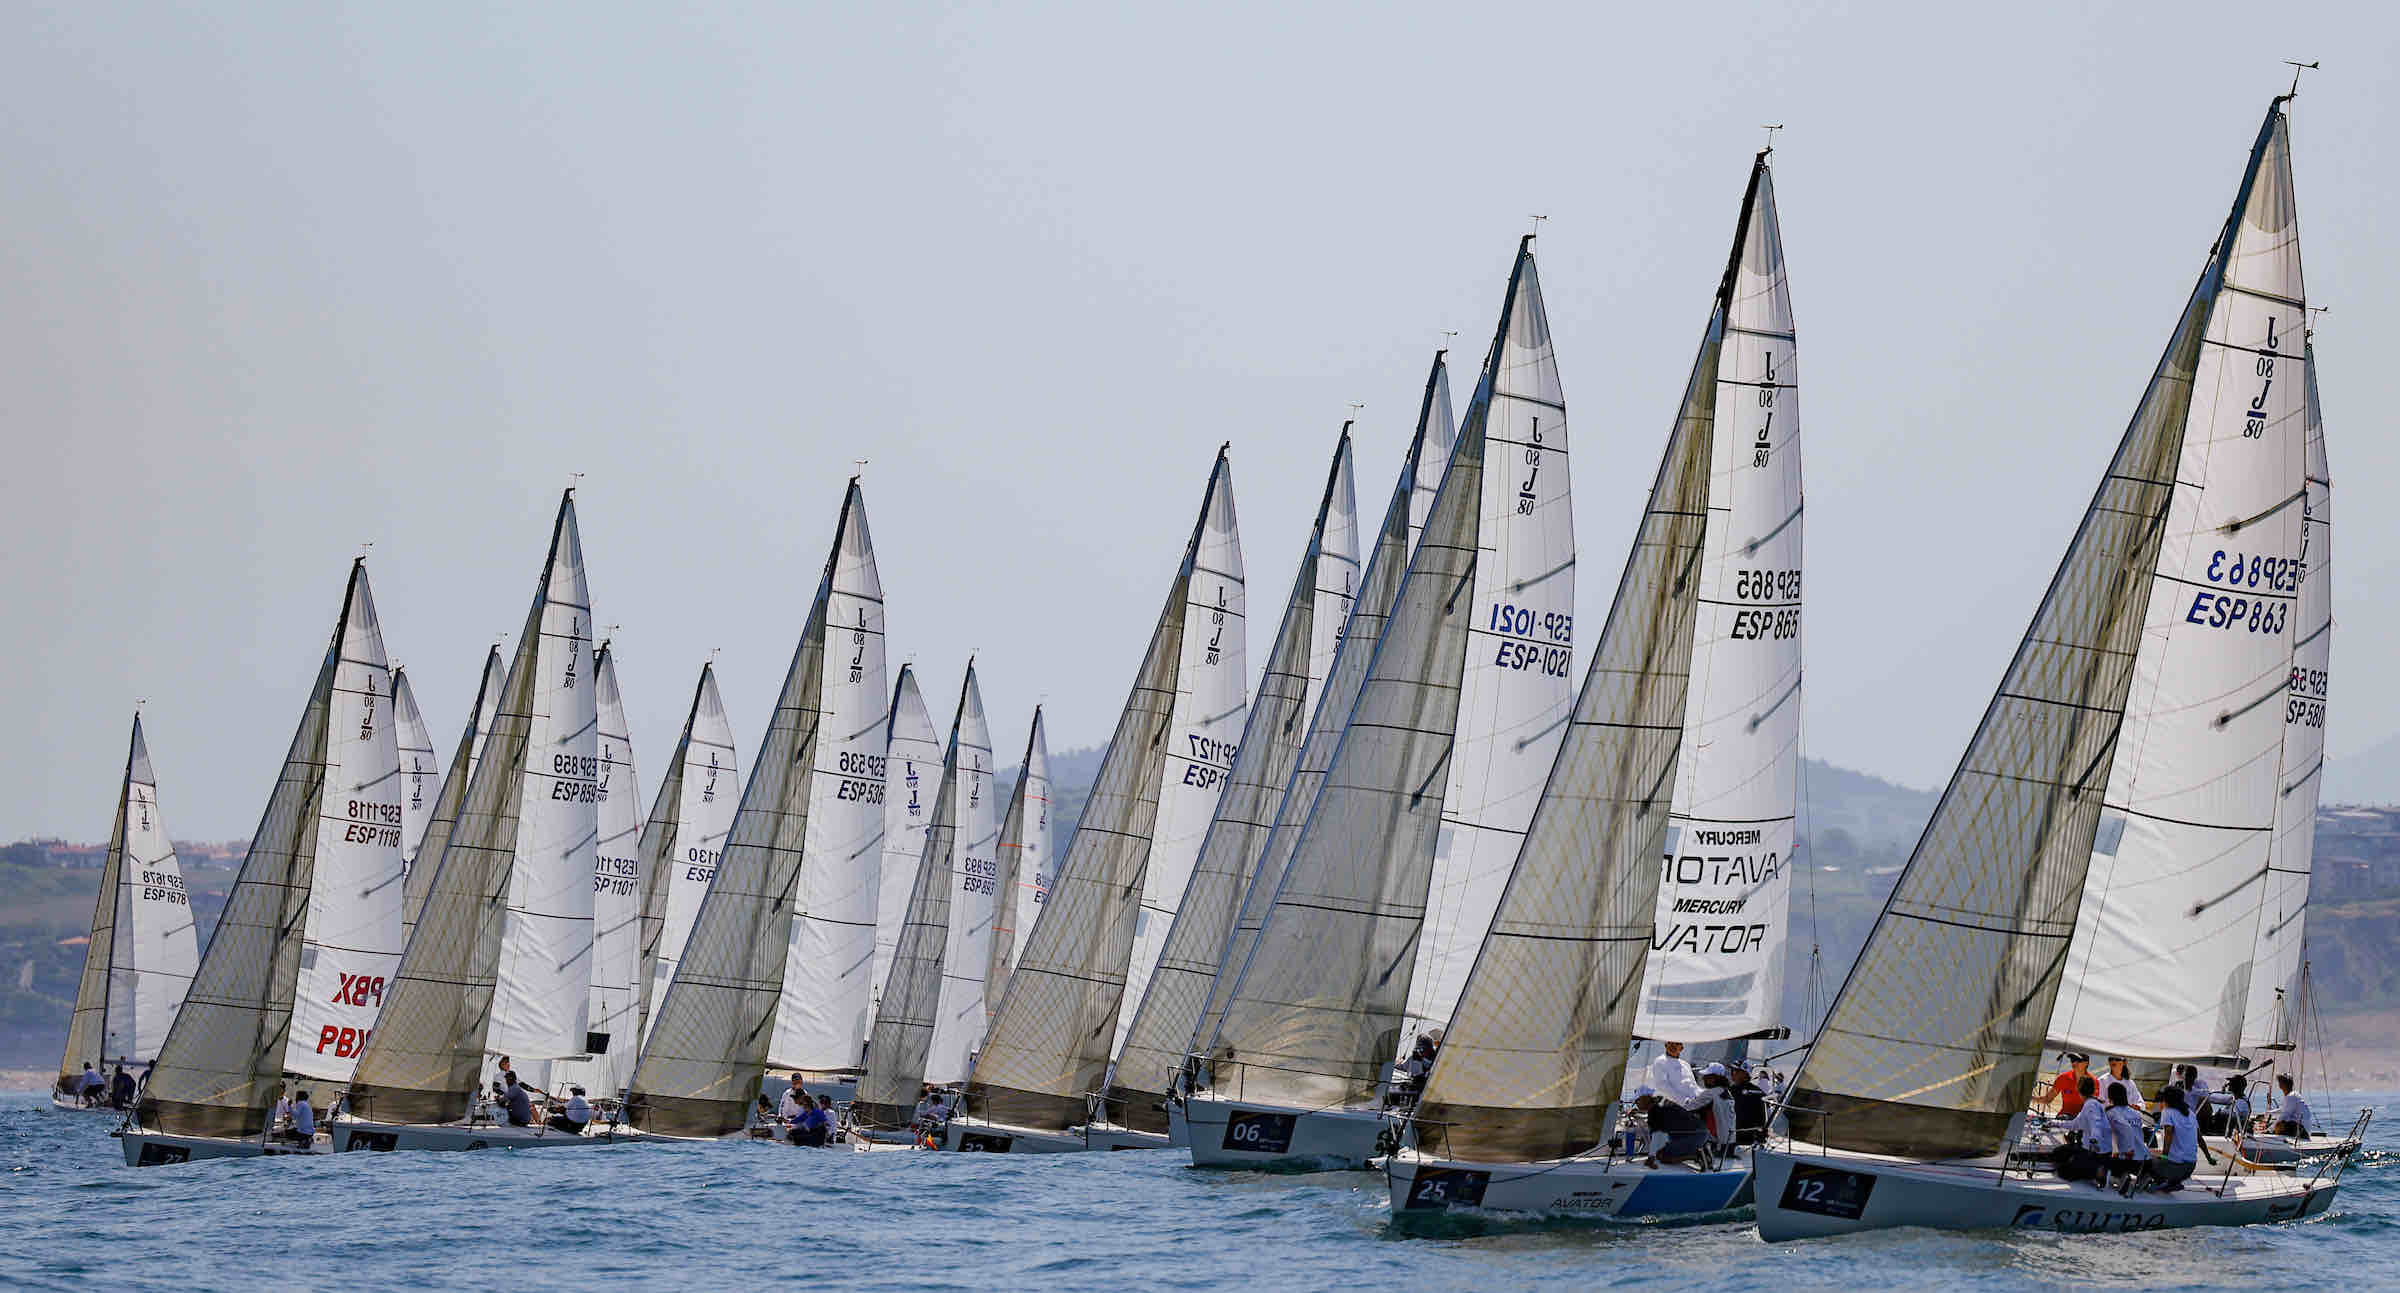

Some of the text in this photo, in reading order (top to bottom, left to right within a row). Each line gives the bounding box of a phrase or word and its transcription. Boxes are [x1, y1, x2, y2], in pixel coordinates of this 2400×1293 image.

[2251, 380, 2273, 410] J
[1758, 412, 1773, 441] J
[2243, 417, 2264, 440] 80
[1752, 448, 1769, 468] 80
[1522, 467, 1538, 492] J
[1517, 499, 1534, 516] 80
[1210, 627, 1223, 647] J
[567, 653, 579, 673] J
[852, 646, 864, 666] J
[1205, 651, 1219, 666] 80
[563, 676, 576, 690] 80
[849, 670, 862, 684] 80
[363, 708, 373, 726] J
[2287, 699, 2306, 725] SP
[360, 729, 373, 741] 80
[599, 774, 610, 789] J
[908, 790, 918, 806] J
[345, 824, 401, 848] ESP 1118
[594, 875, 611, 893] SP
[143, 887, 166, 902] ESP
[1672, 898, 1748, 915] MERCURY
[1651, 922, 1766, 954] VATOR
[1232, 1121, 1262, 1142] 06
[1416, 1179, 1450, 1201] 25
[1796, 1178, 1826, 1203] 12
